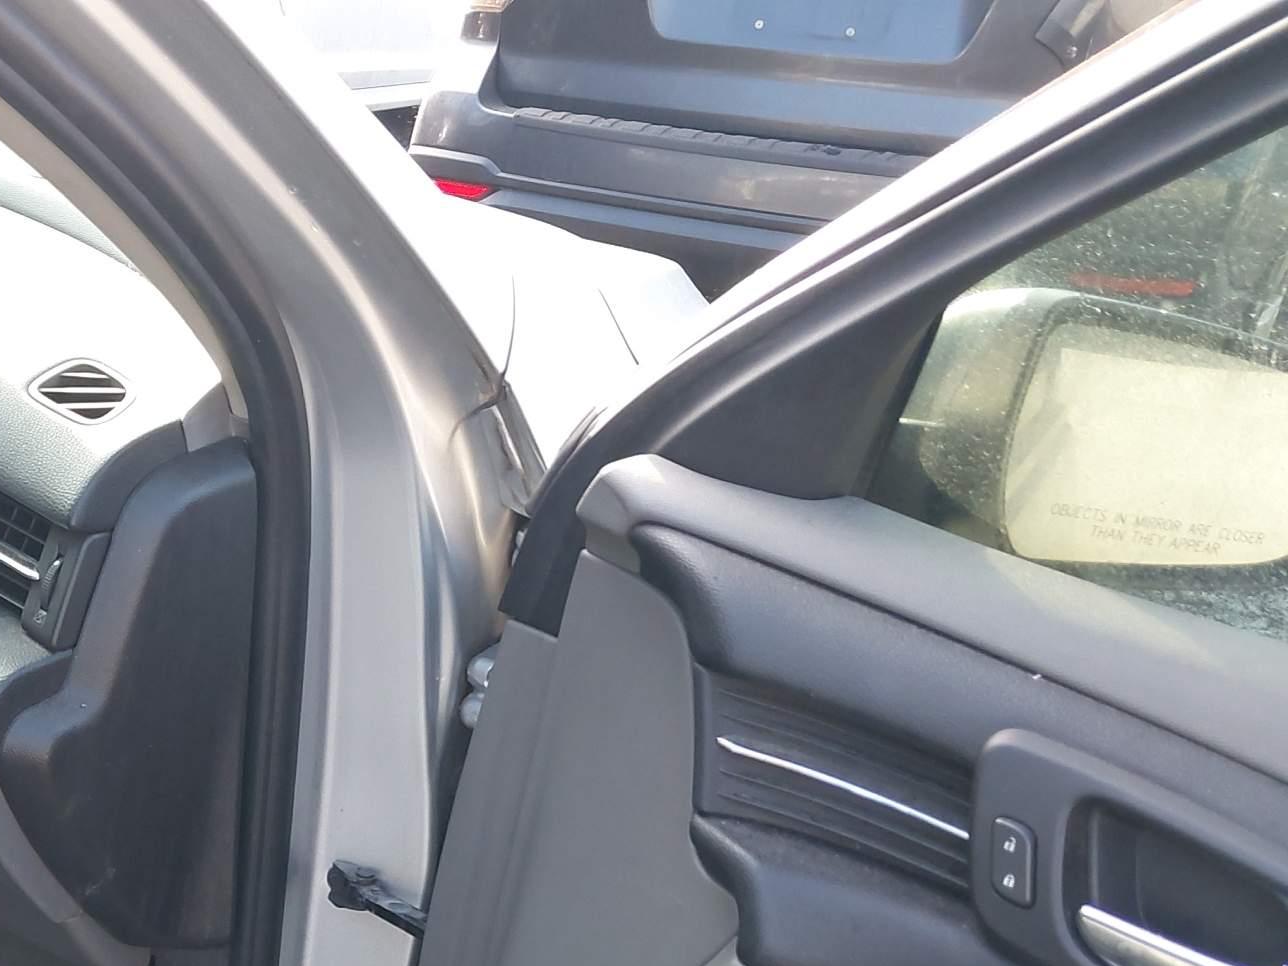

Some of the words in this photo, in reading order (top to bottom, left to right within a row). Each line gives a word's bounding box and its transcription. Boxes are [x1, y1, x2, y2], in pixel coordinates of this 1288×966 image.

[1050, 503, 1108, 523] OBJECTS
[1114, 512, 1127, 525] IN
[1135, 512, 1183, 532] MIRROR
[1189, 521, 1213, 538] ARE
[1218, 527, 1266, 545] CLOSER
[1089, 524, 1125, 542] THAN
[1133, 530, 1166, 546] THEY
[1168, 537, 1222, 555] APPEAR
